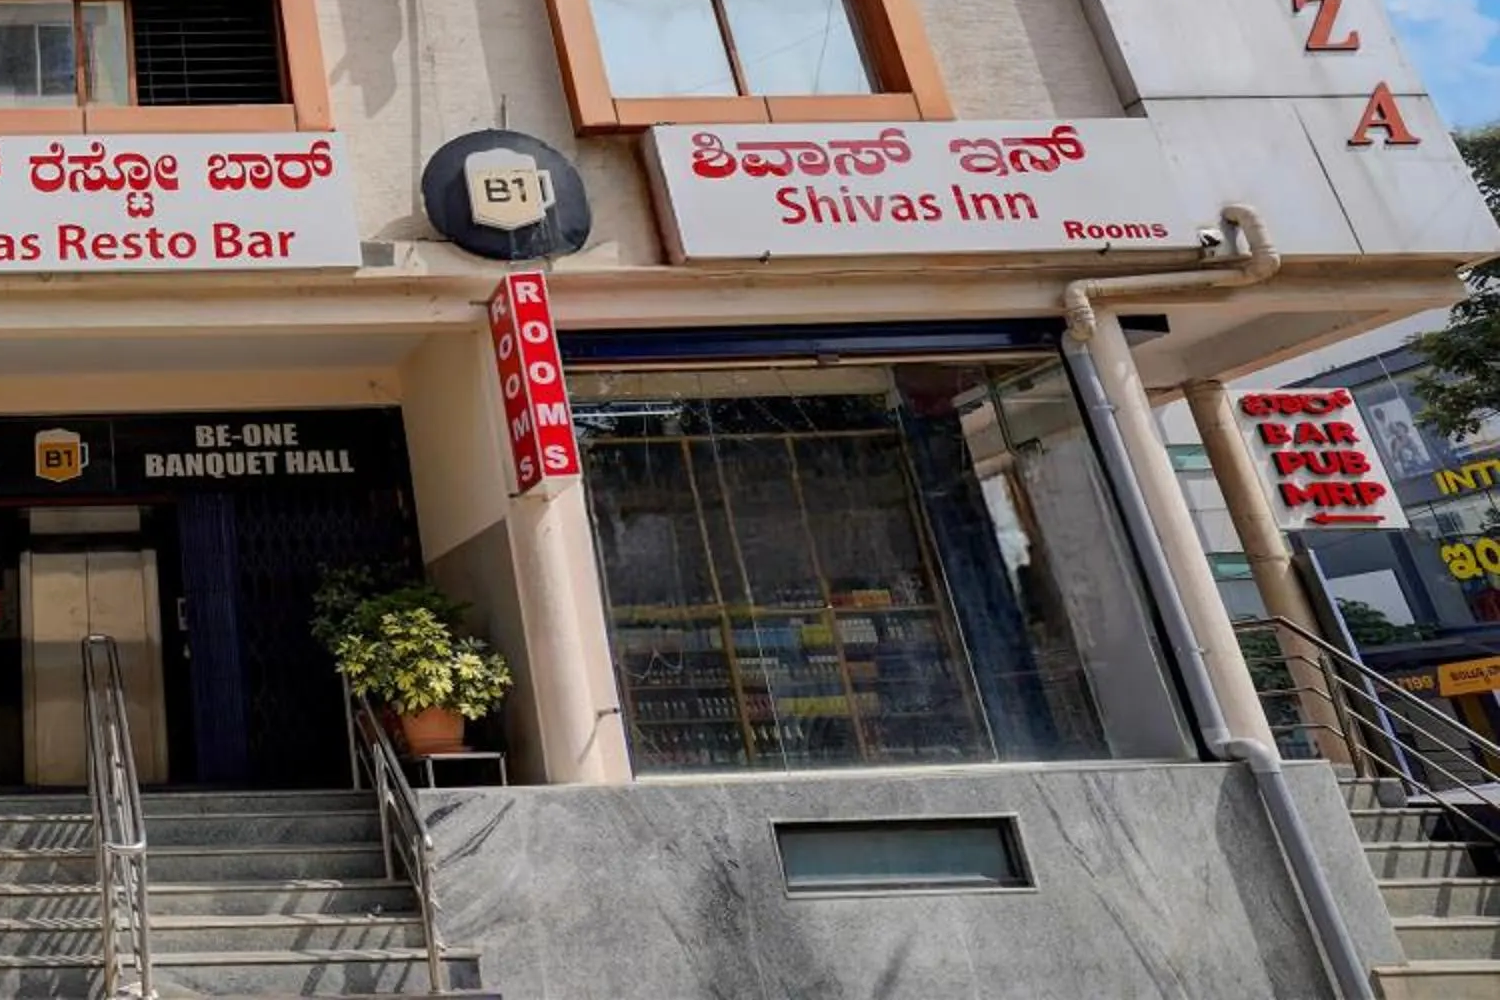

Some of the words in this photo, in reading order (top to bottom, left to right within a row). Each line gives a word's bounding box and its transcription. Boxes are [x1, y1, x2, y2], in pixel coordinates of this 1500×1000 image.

[207, 140, 333, 191] ಬಾರ್
[690, 127, 912, 180] ಶಿವಾಸ್
[949, 125, 1086, 177] ಇನ್
[485, 177, 528, 203] B1
[774, 184, 943, 226] Shivas
[951, 184, 1039, 221] Inn
[57, 223, 197, 262] Resto
[212, 221, 296, 260] Bar
[1063, 220, 1169, 240] Rooms
[492, 294, 534, 482] ROOMS
[514, 280, 570, 470] ROOMS
[195, 423, 299, 448] BE-ONE
[1258, 421, 1360, 446] BAR
[45, 451, 74, 467] B1
[145, 451, 278, 478] BANQUET
[285, 450, 355, 474] HALL
[1272, 450, 1371, 475] PUB
[1278, 481, 1387, 507] MRP
